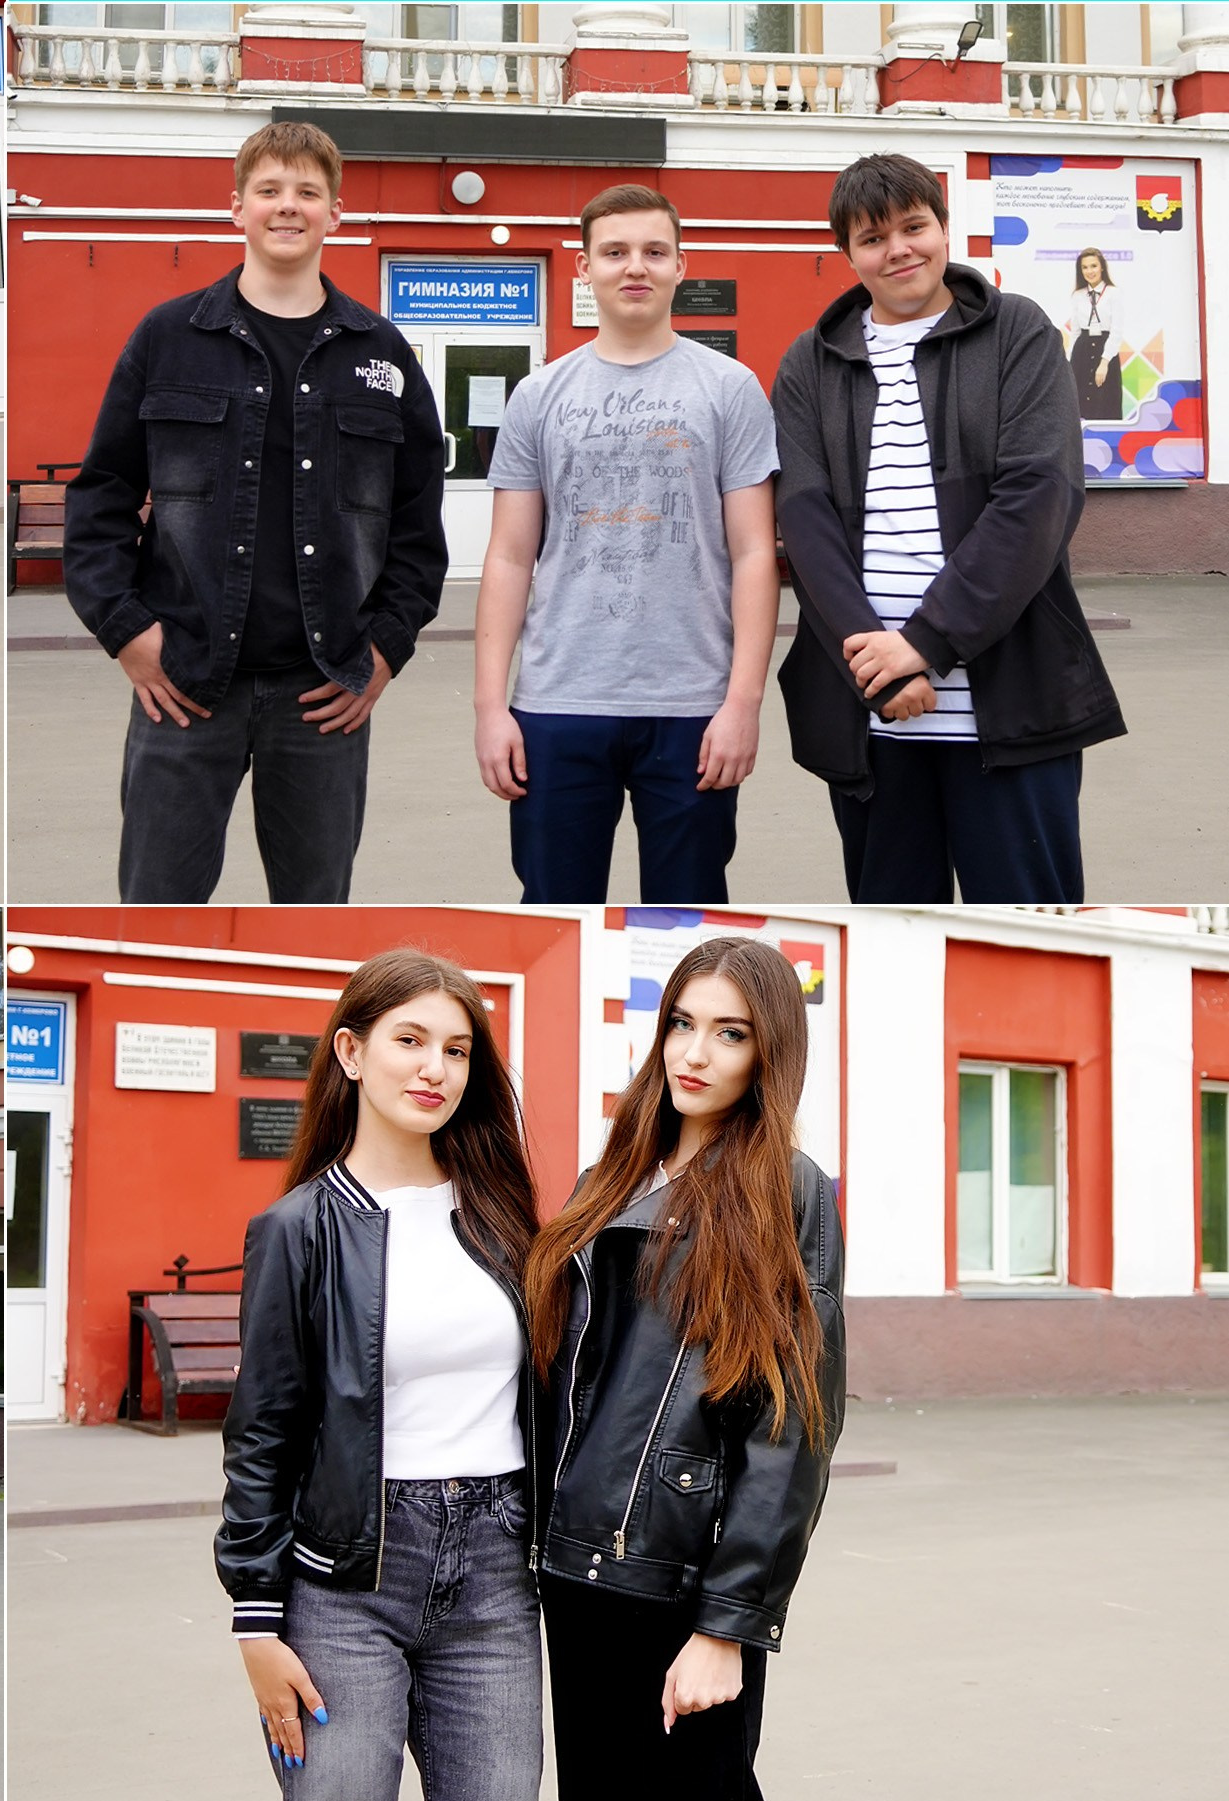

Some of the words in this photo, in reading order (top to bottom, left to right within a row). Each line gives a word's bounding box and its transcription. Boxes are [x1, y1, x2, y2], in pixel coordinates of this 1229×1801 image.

[398, 282, 495, 297] ГИМНАЗИЯ
[500, 283, 529, 298] №1
[370, 359, 392, 371] THE
[355, 366, 392, 381] NORTH
[366, 378, 392, 392] FACE
[554, 400, 595, 429] New
[580, 409, 688, 442] Louisiana
[11, 1024, 51, 1047] №1
